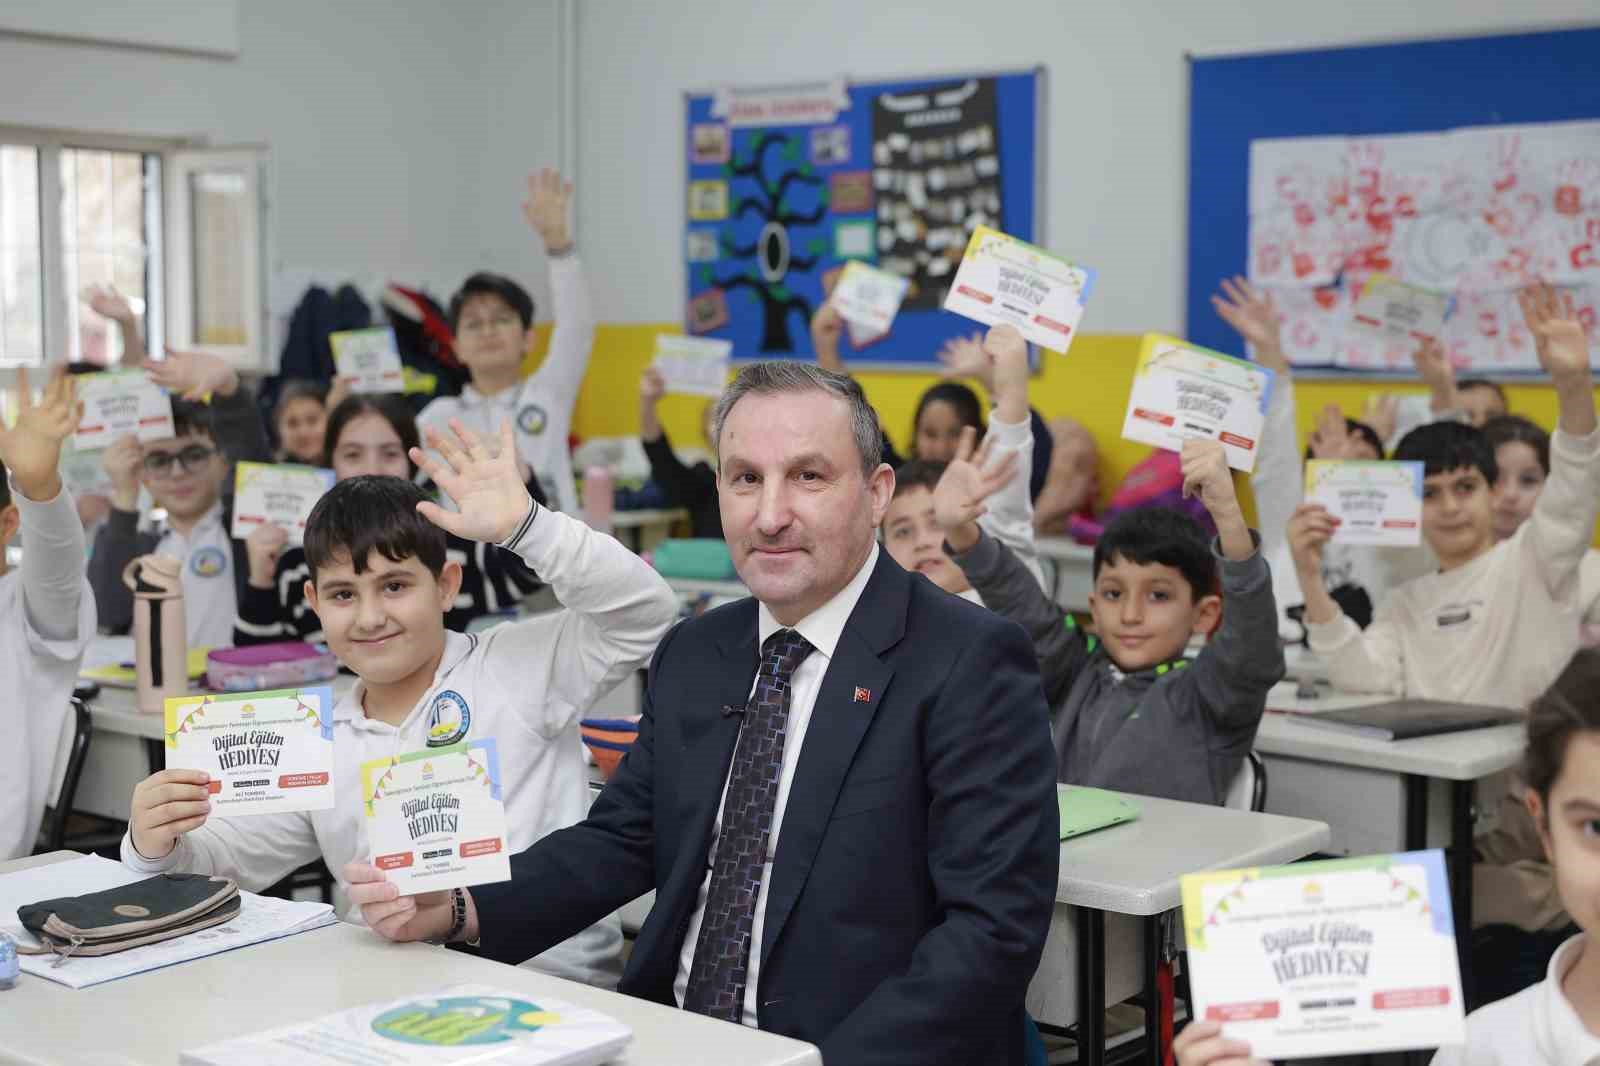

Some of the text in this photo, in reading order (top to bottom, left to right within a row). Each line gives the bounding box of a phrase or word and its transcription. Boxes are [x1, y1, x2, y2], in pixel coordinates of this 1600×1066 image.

[212, 729, 285, 752] Dijital Eğitim
[401, 793, 460, 819] Dijital Eğitim
